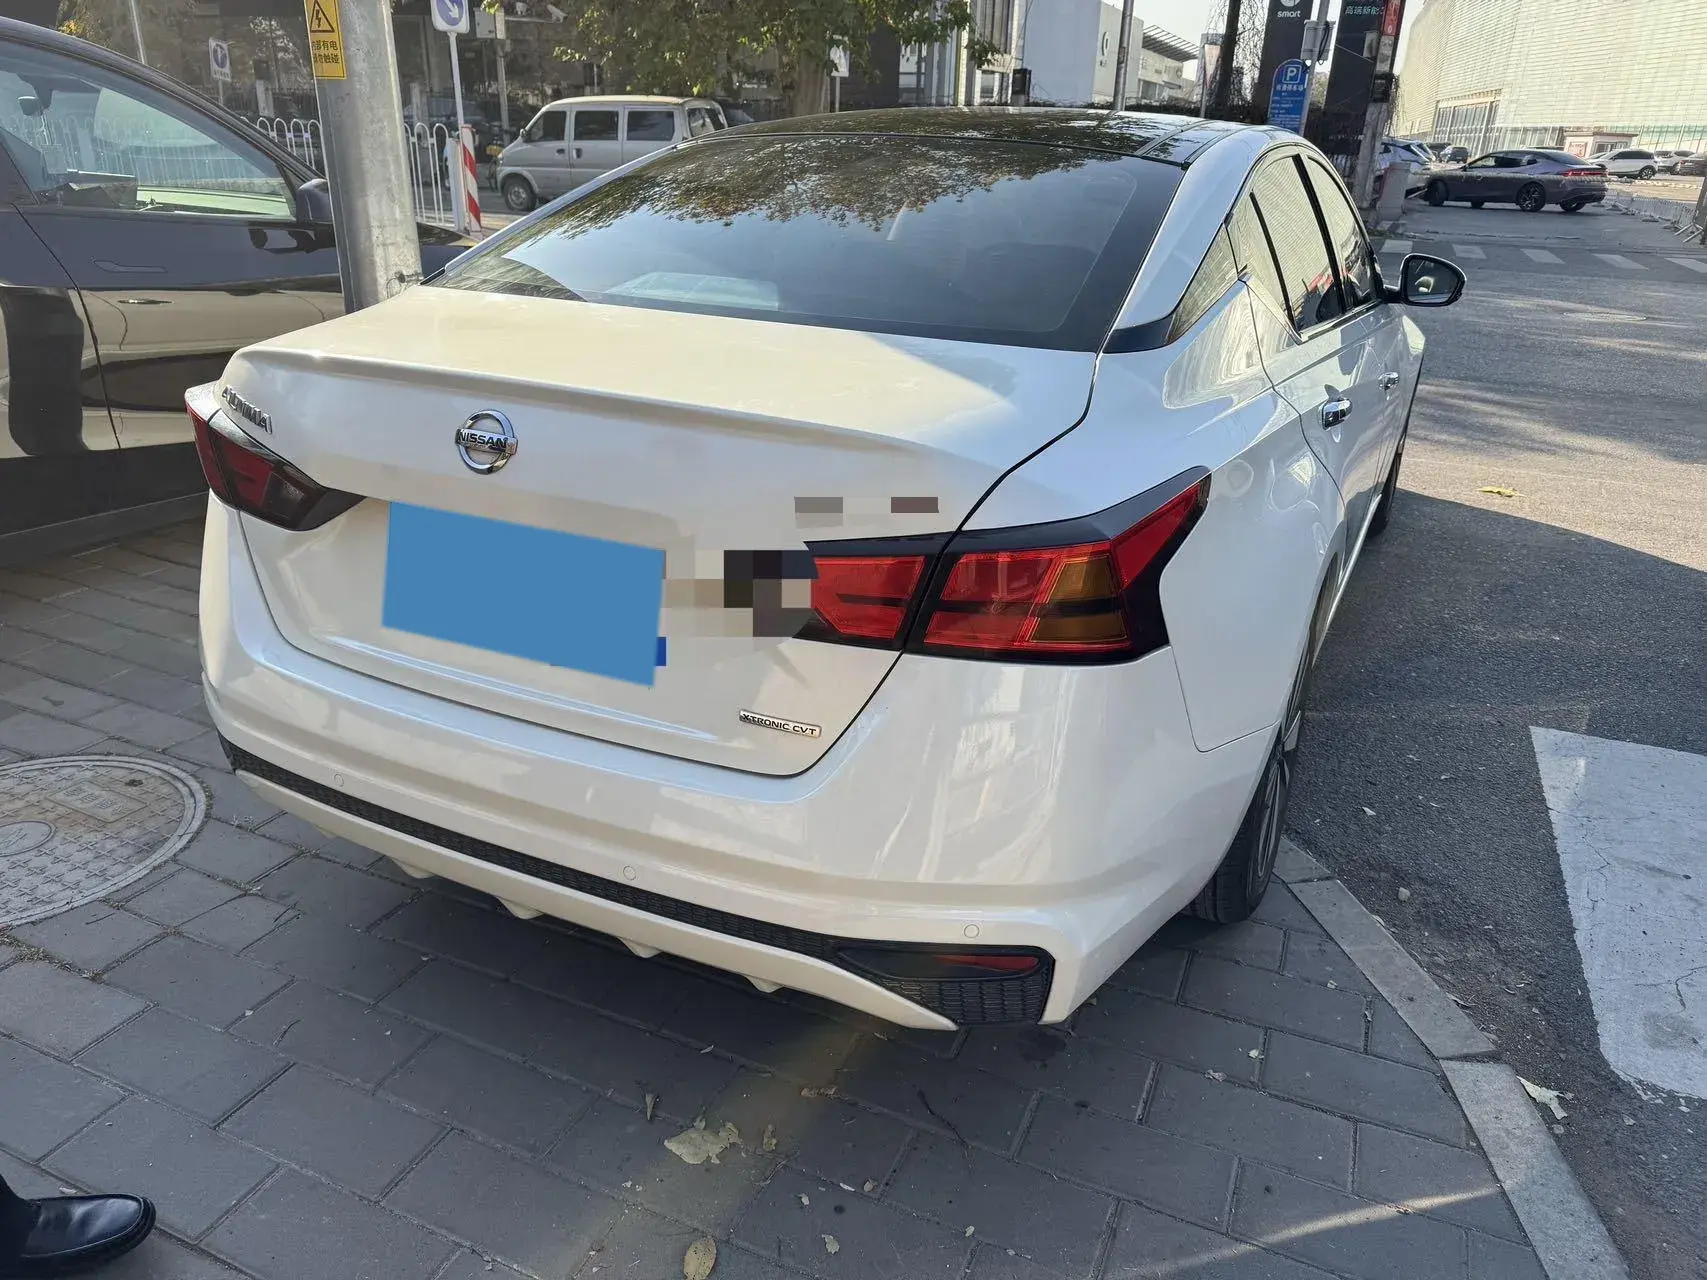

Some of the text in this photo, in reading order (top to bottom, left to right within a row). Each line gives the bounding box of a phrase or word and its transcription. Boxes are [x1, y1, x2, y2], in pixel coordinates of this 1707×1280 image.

[1277, 10, 1301, 18] smart
[1286, 67, 1297, 81] P
[457, 430, 508, 449] NISSAN
[742, 713, 817, 735] XTRONIC CVT
